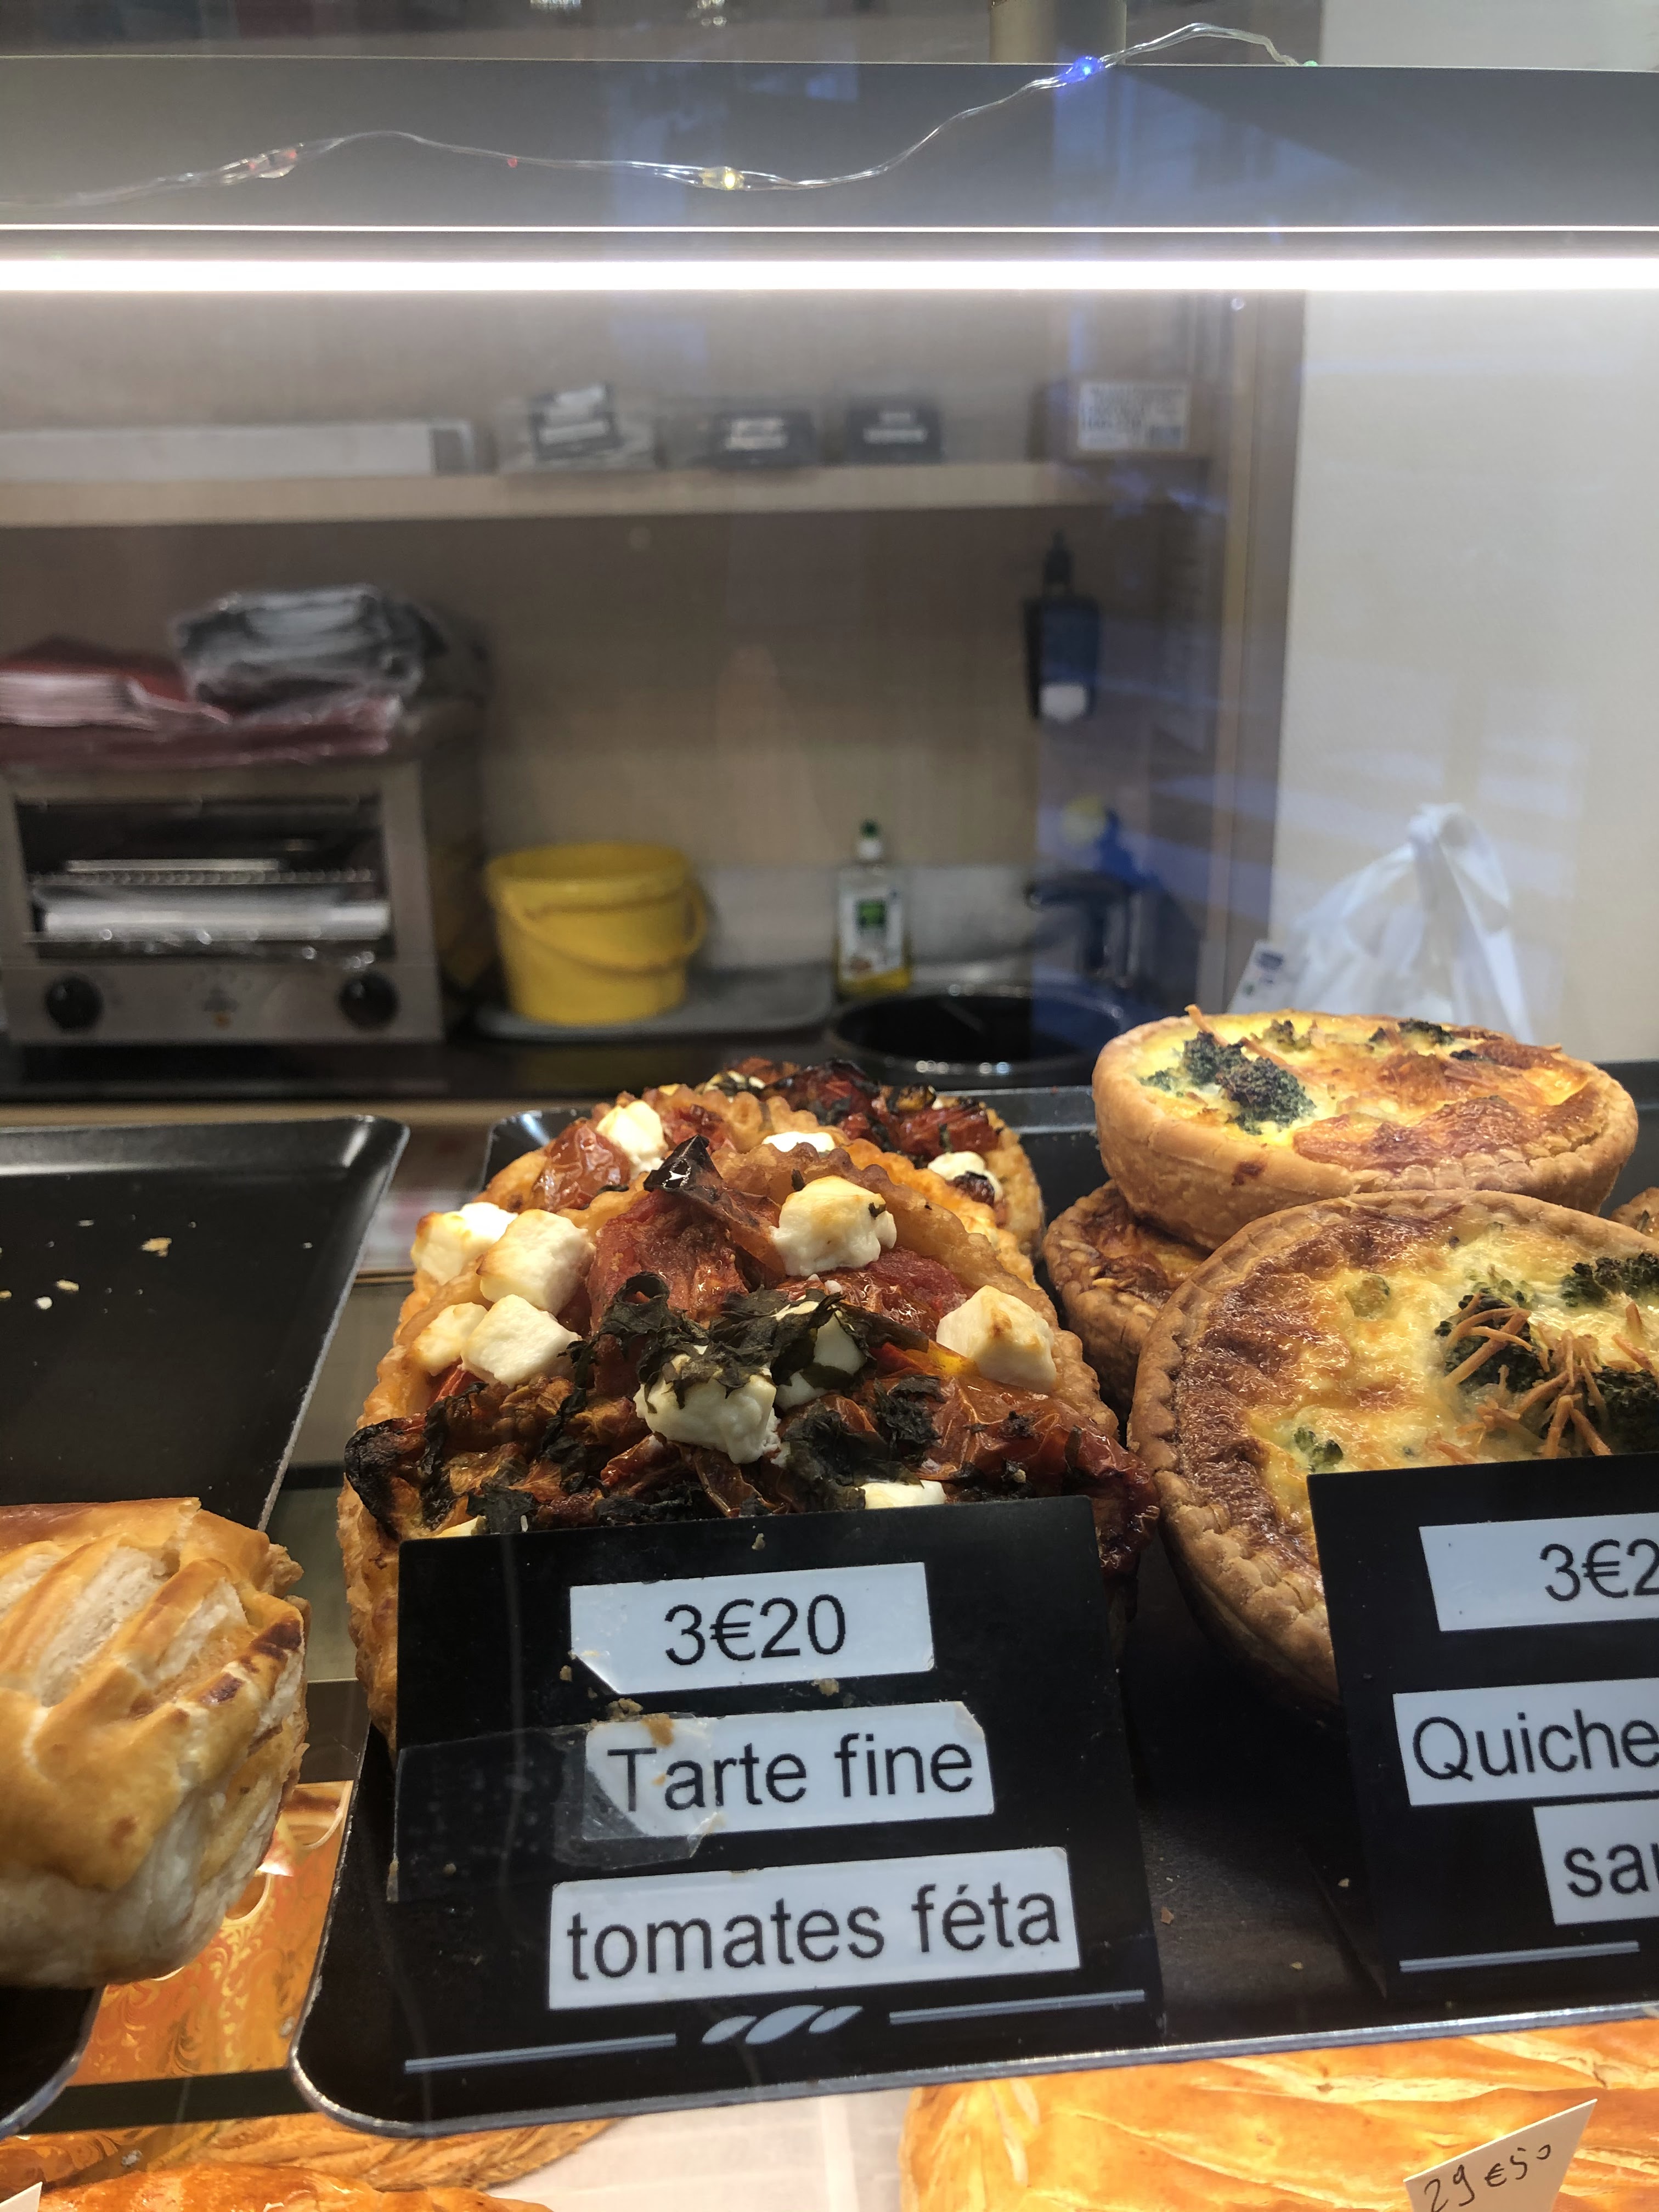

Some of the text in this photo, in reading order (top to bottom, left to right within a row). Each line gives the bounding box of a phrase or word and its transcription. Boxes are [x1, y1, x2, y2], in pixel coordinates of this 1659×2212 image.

[664, 1594, 847, 1666] 3€20
[607, 1733, 973, 1812] Tarte fine
[1412, 1708, 1659, 1781] Quiche
[1564, 1842, 1659, 1898] sa
[566, 1883, 1059, 1980] tomates féta
